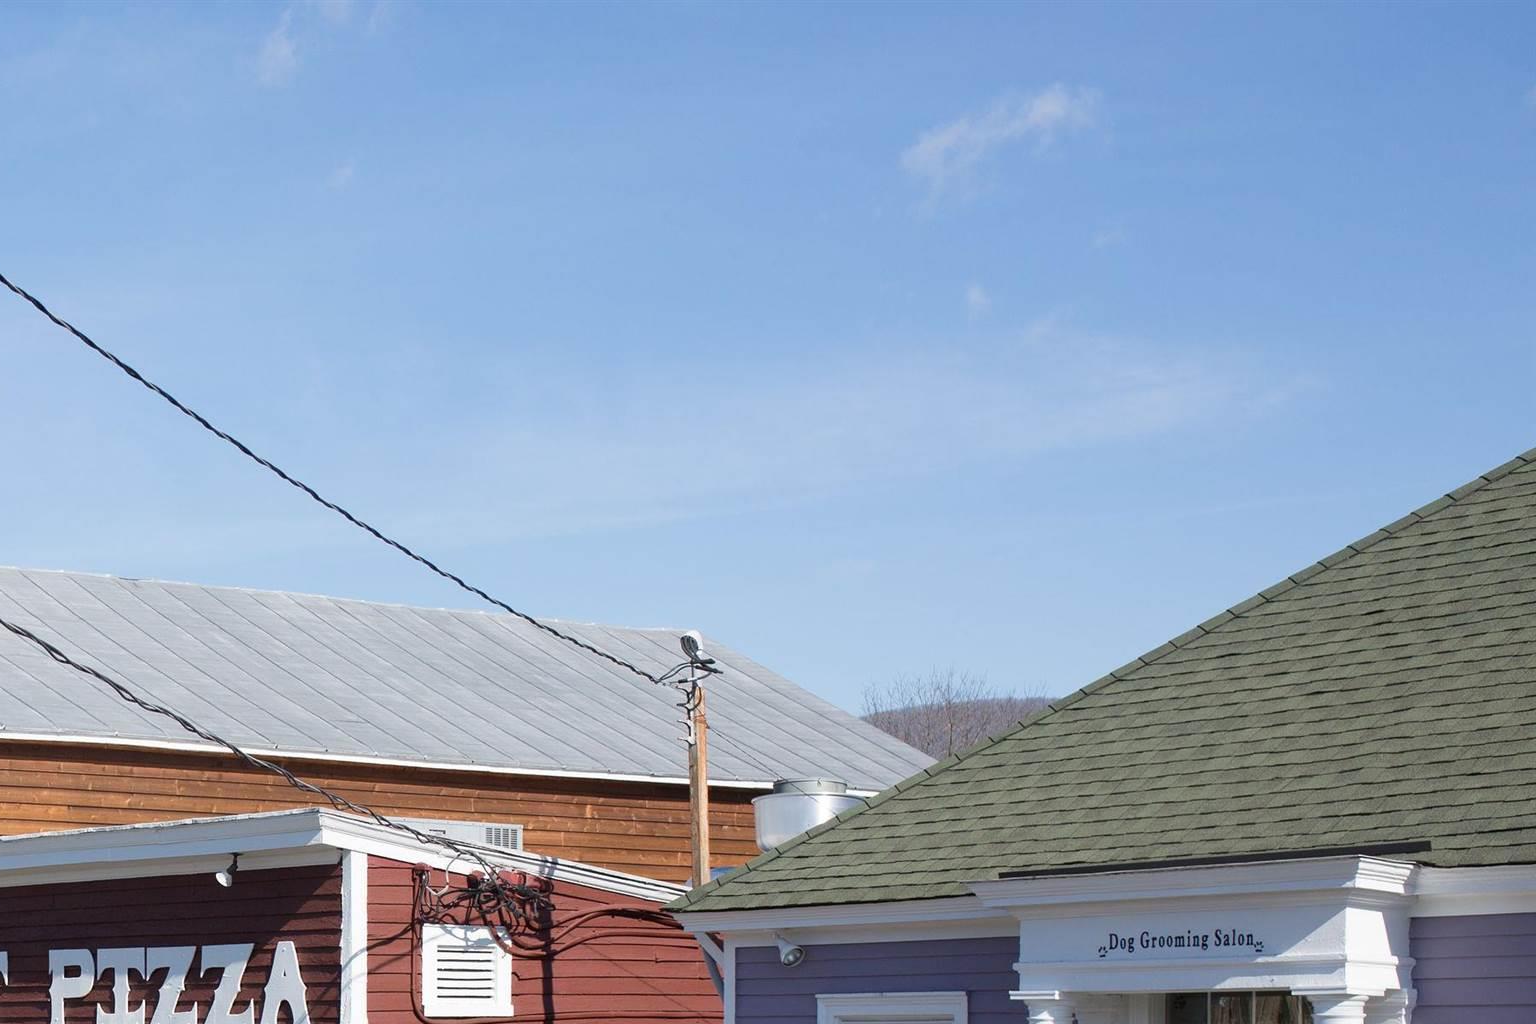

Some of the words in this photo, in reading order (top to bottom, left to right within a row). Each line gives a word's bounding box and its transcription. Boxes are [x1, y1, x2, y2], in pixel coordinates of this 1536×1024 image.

[1109, 933, 1135, 953] Dog
[1140, 930, 1209, 951] Grooming
[1214, 929, 1254, 947] Salon
